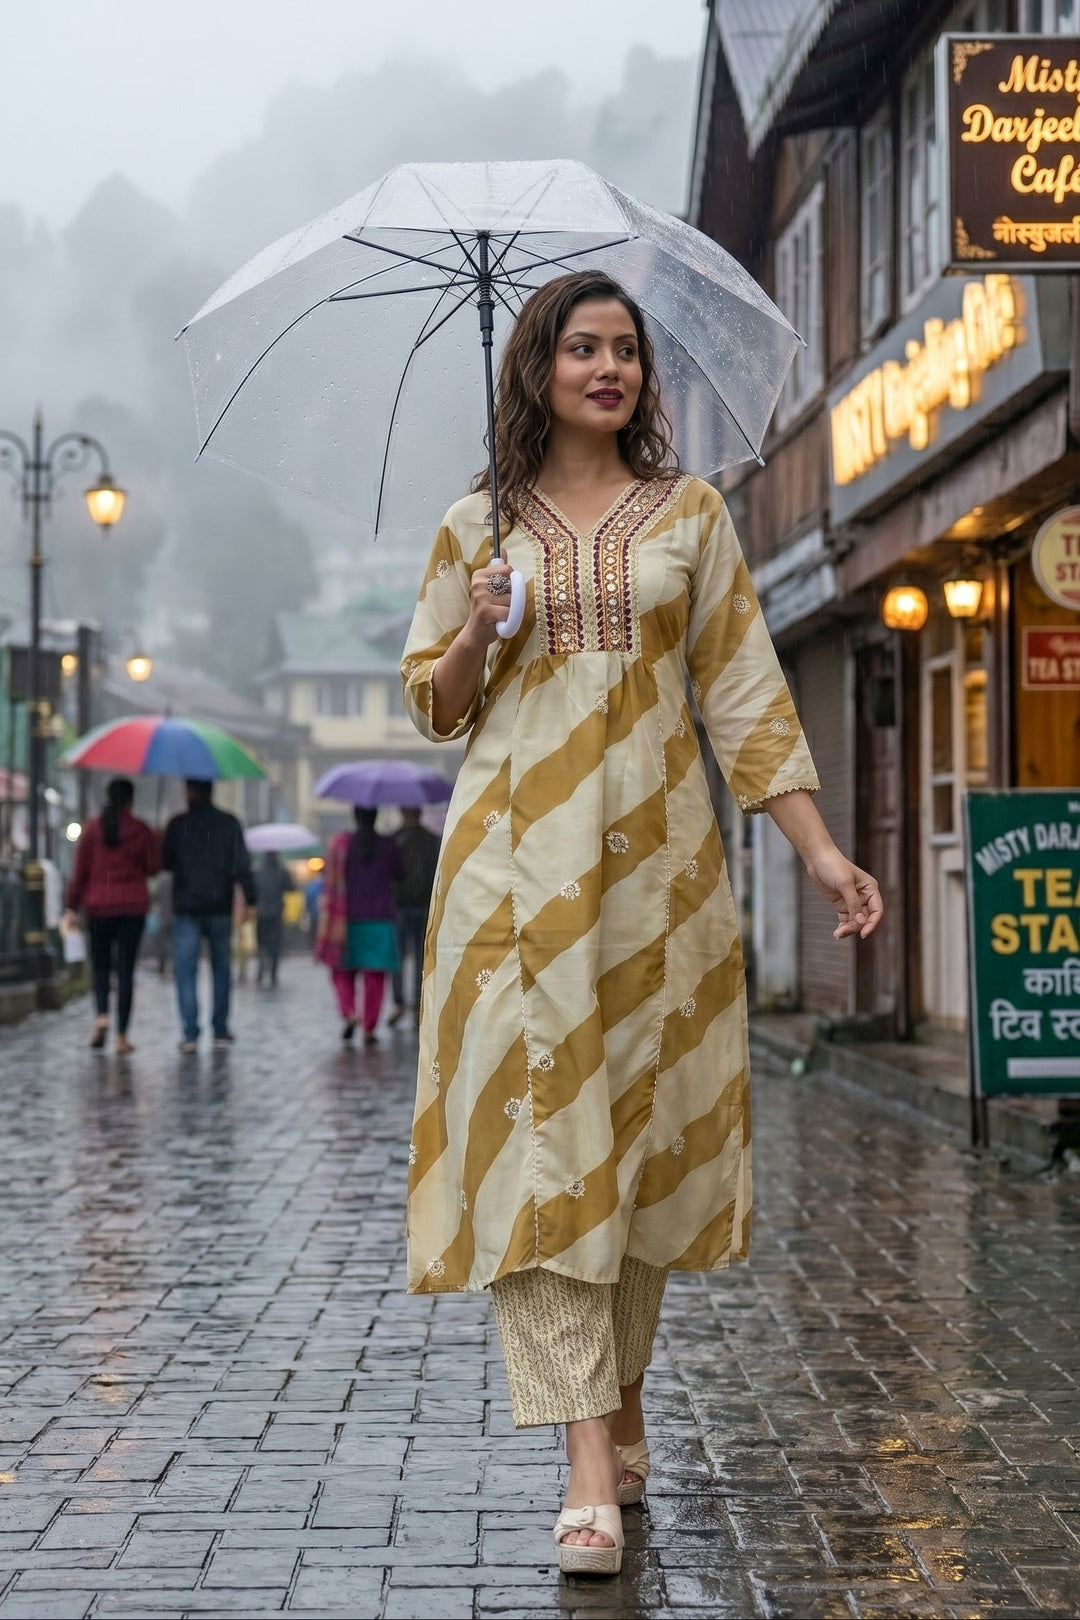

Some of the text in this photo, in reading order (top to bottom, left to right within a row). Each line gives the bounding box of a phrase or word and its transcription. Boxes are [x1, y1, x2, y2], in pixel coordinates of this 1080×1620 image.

[1062, 532, 1080, 557] T
[1056, 562, 1080, 582] ST
[974, 826, 1032, 877] MISTY
